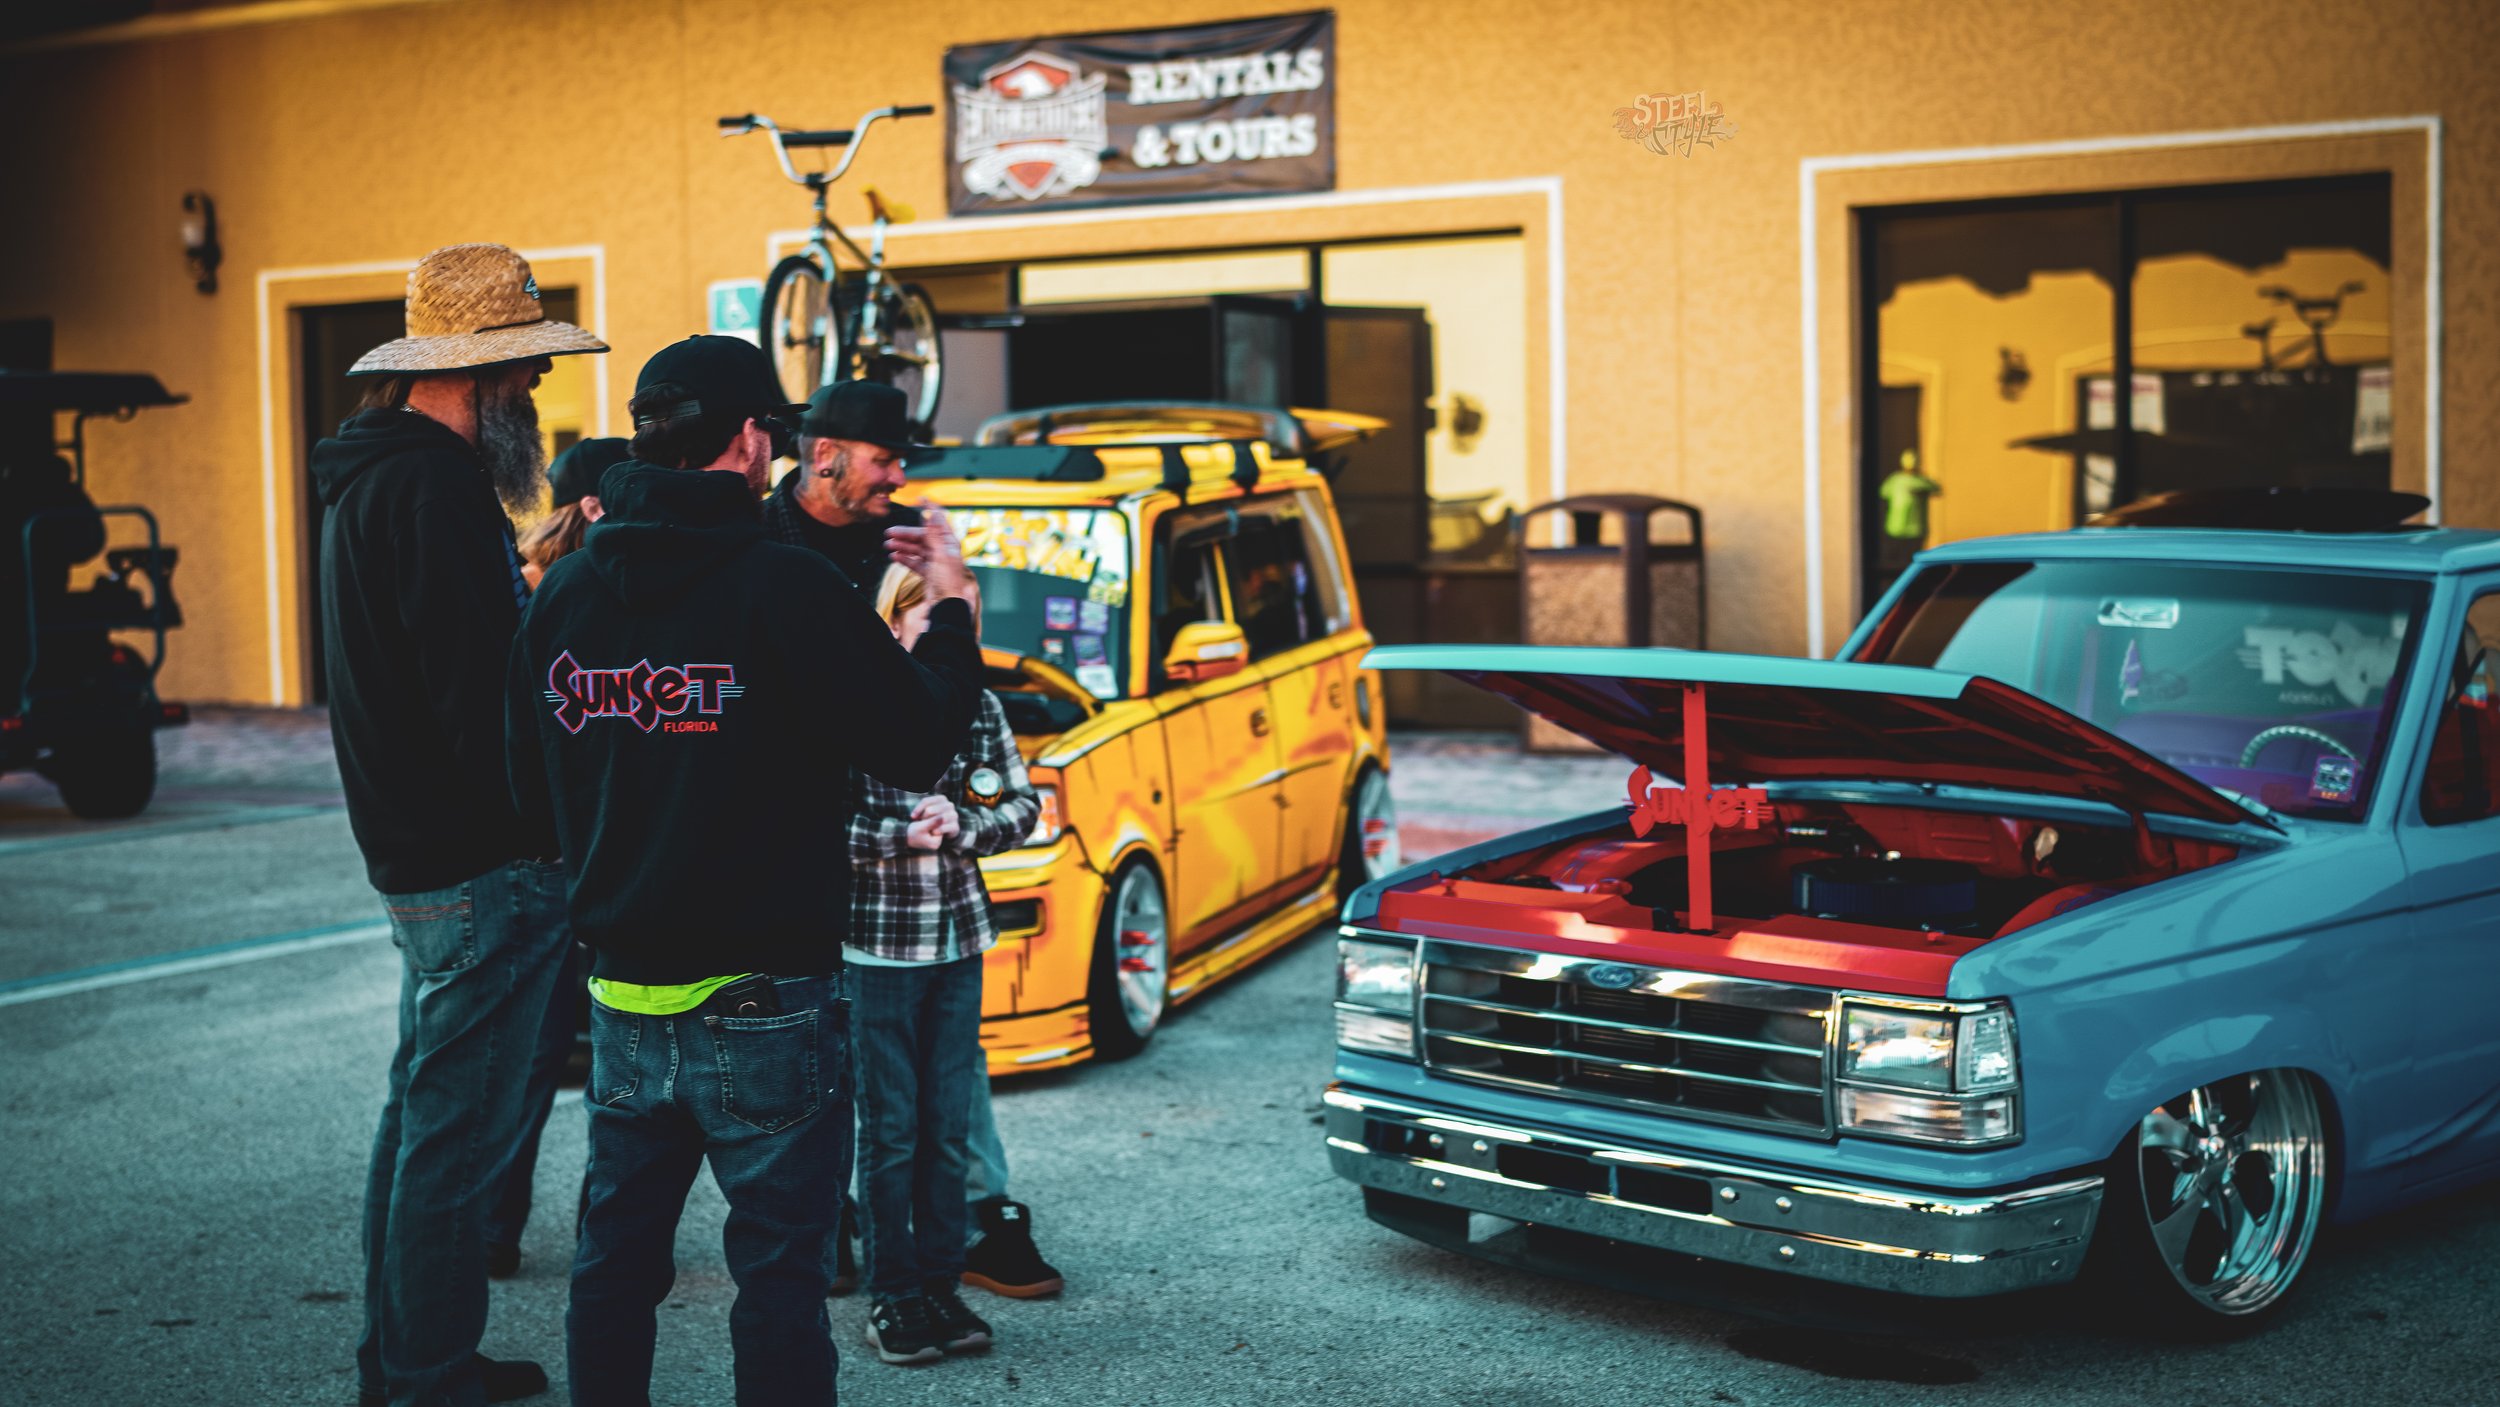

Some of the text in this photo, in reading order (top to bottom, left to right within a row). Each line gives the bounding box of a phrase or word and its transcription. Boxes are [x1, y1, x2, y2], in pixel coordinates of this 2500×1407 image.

[1127, 49, 1325, 105] RENTALS
[1131, 113, 1317, 168] & TOURS
[663, 720, 719, 733] FLORIDA
